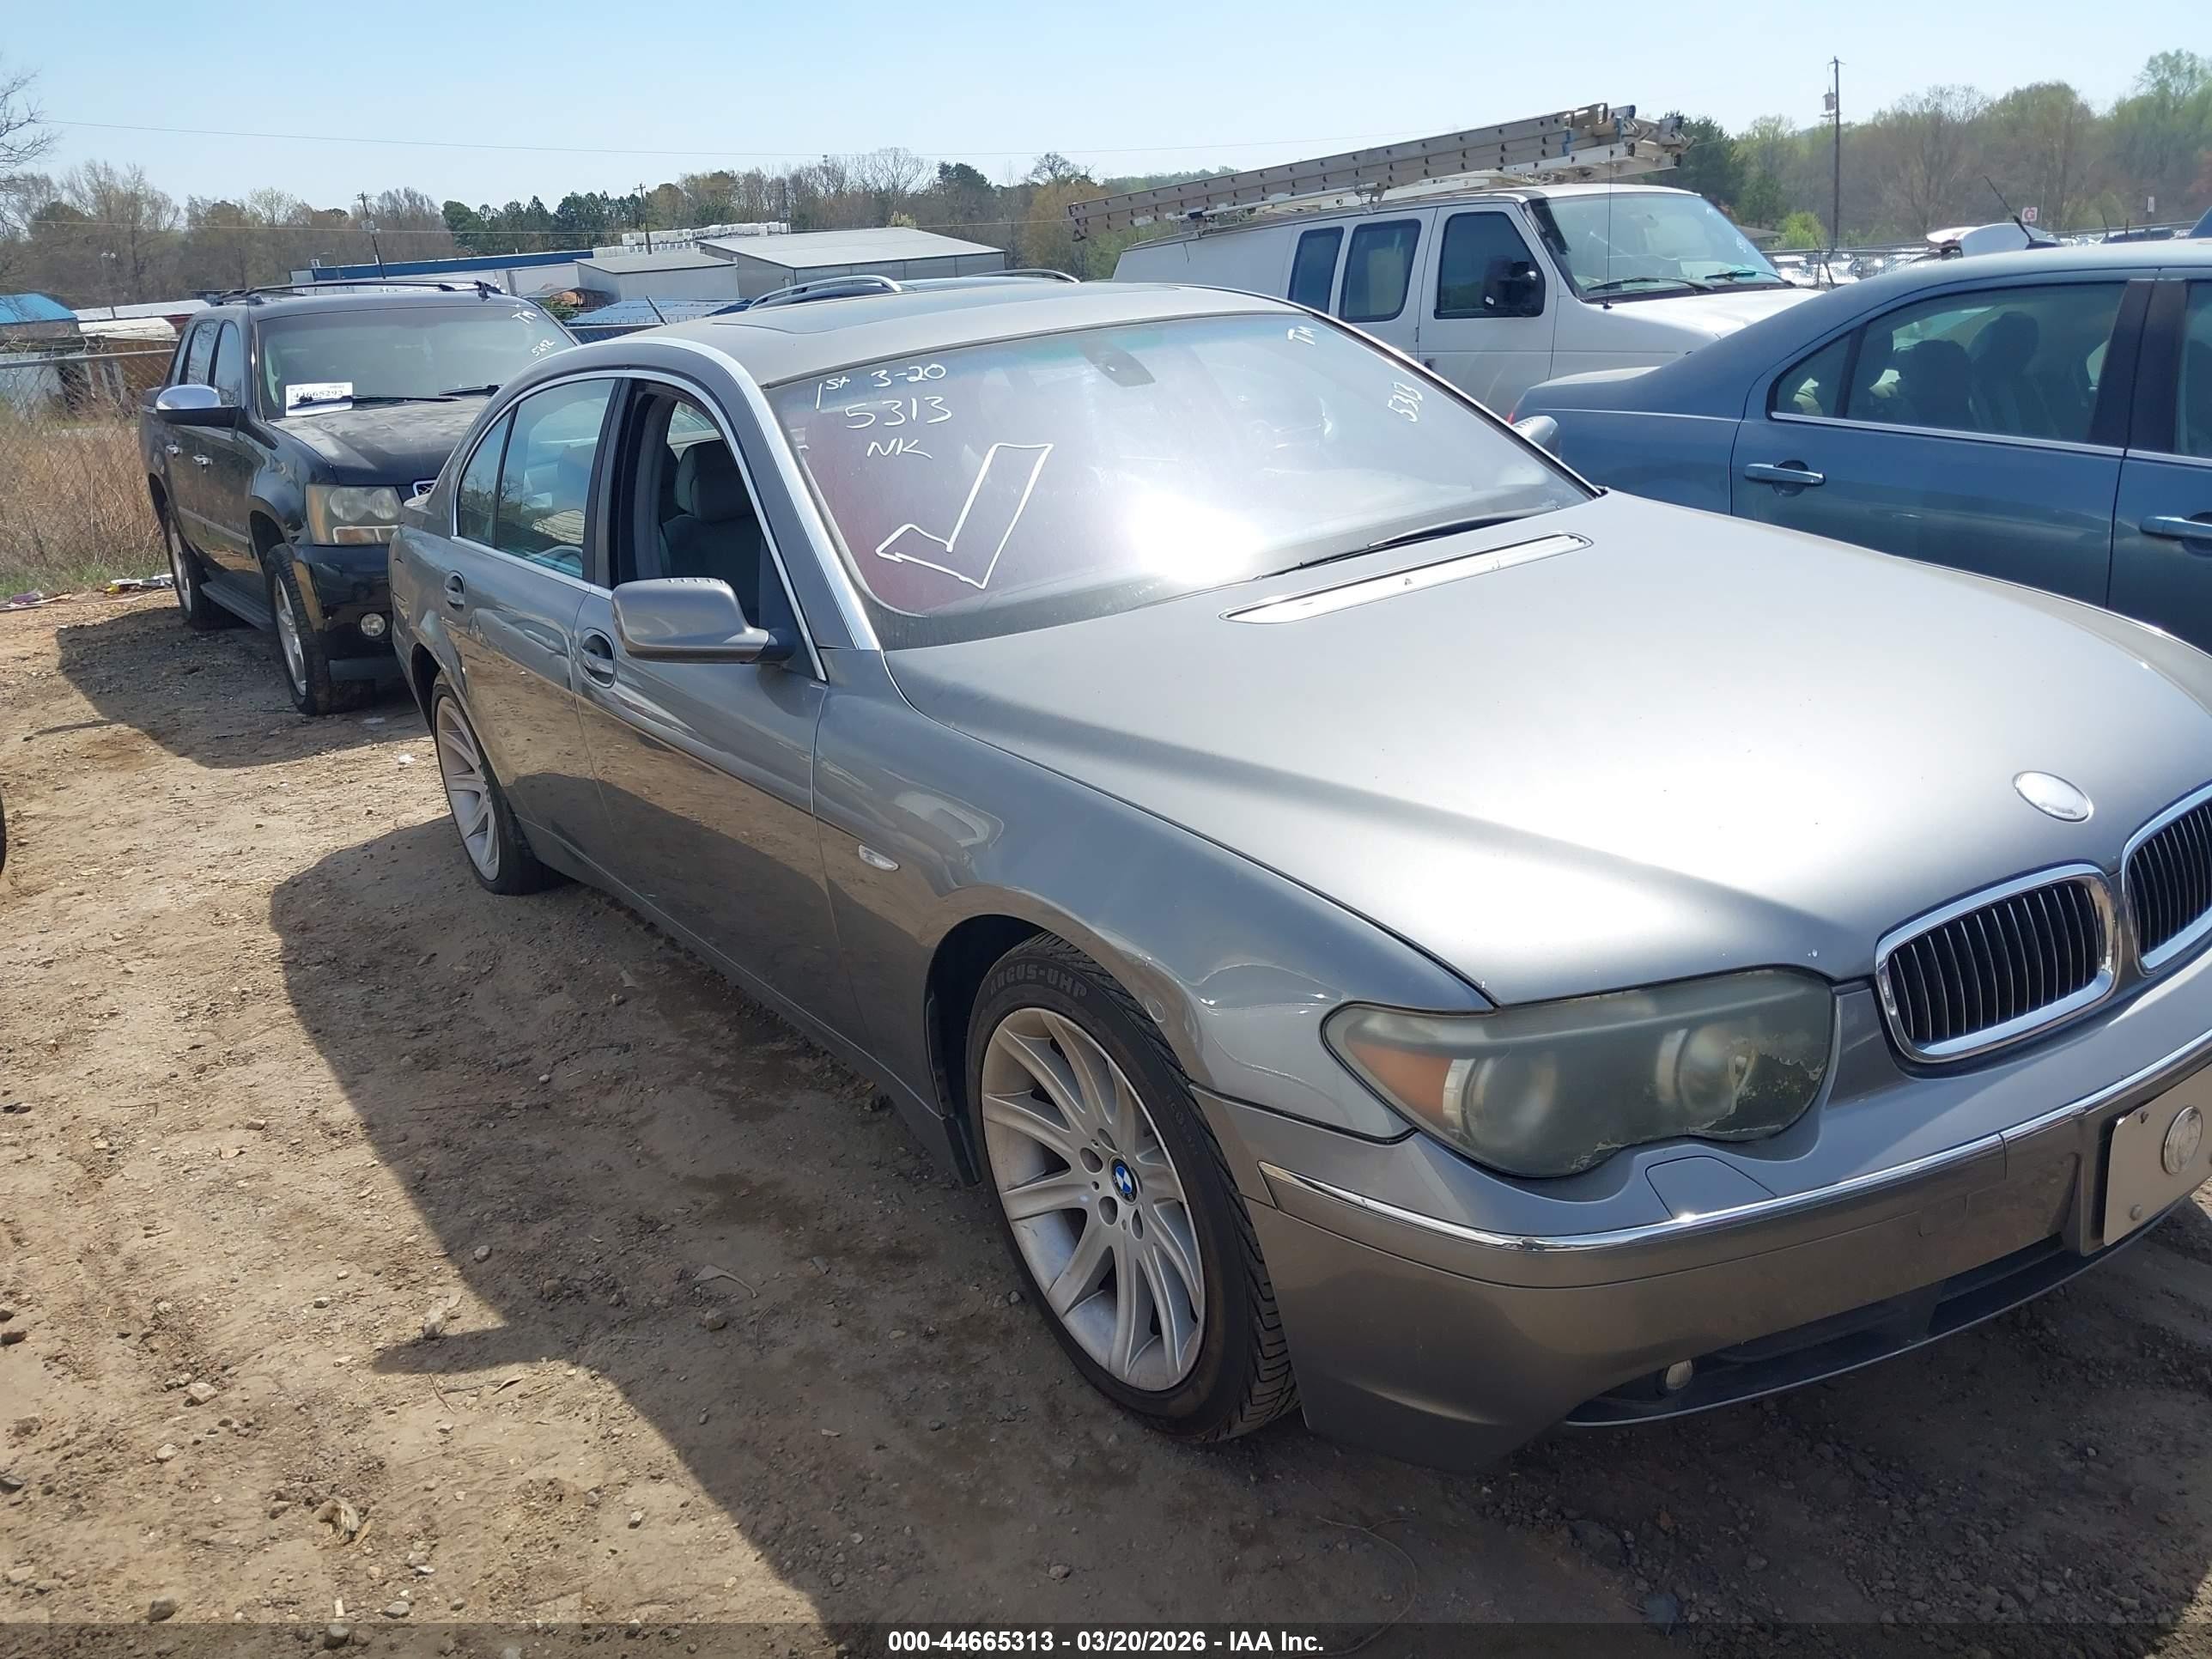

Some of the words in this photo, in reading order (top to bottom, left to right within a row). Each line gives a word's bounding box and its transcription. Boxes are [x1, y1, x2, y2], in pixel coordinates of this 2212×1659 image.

[532, 339, 556, 356] 5292
[816, 376, 851, 410] 1st
[871, 363, 946, 387] 3-20
[845, 396, 952, 429] 5313
[866, 438, 933, 460] NK
